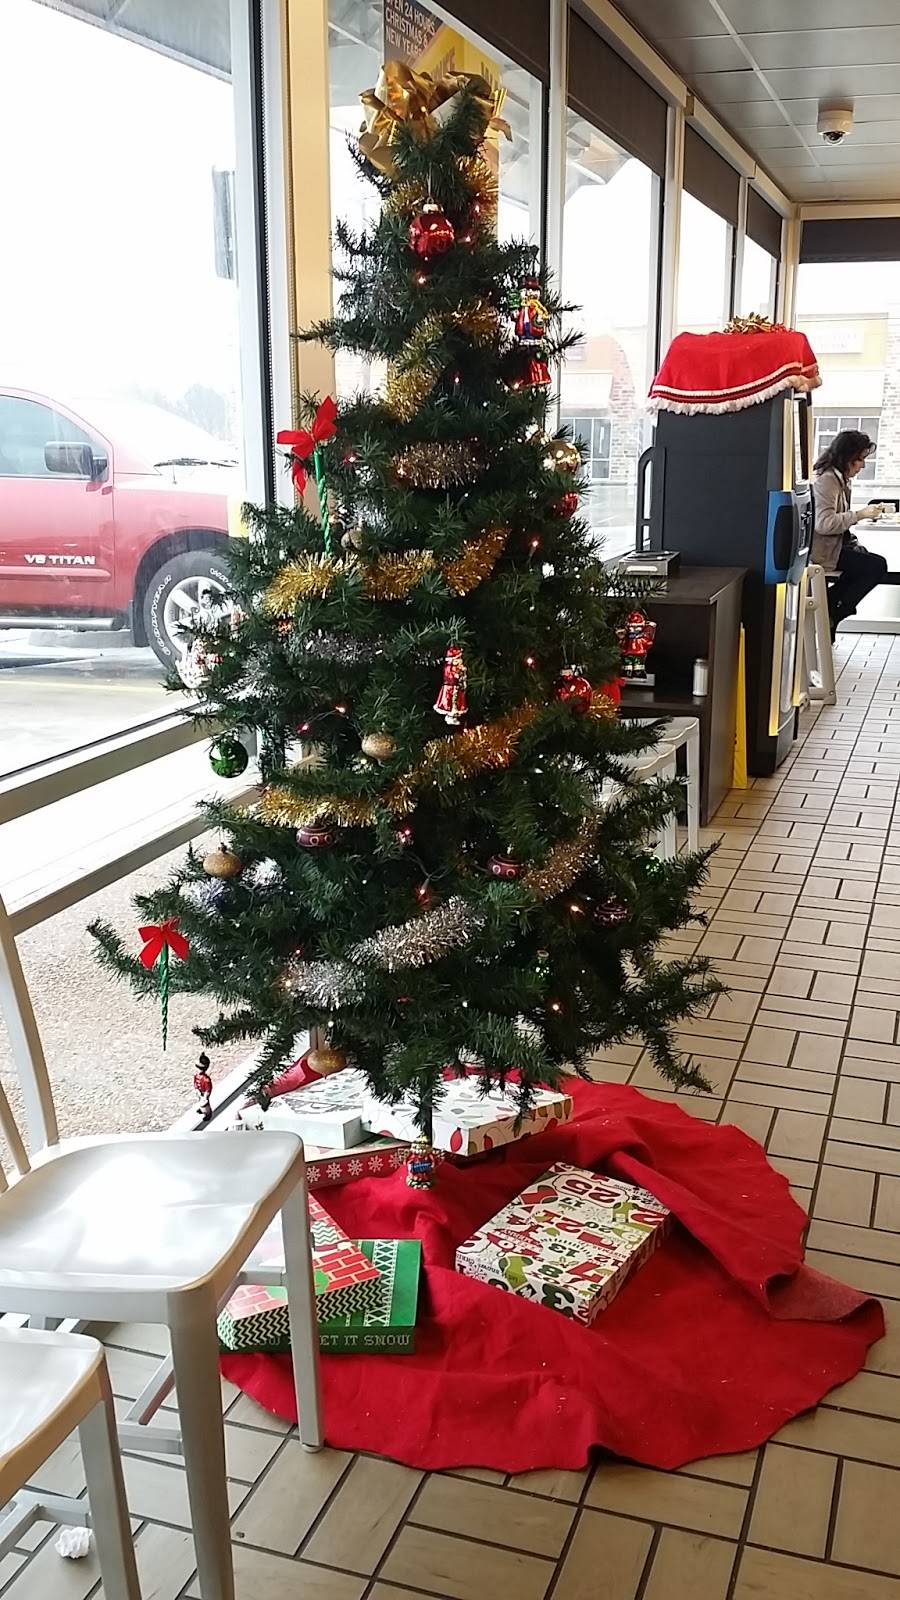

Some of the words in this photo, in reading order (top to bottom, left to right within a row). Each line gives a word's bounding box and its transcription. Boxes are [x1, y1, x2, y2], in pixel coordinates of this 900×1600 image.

[404, 2, 413, 20] 24
[386, 7, 422, 45] CHRISTMAS
[386, 25, 401, 48] NEW
[49, 555, 96, 565] TITAN
[561, 1179, 621, 1204] 25
[548, 1243, 580, 1257] 13
[537, 1265, 564, 1278] 8
[318, 1334, 339, 1346] ET
[343, 1334, 358, 1346] IT
[363, 1334, 411, 1346] SNOW
